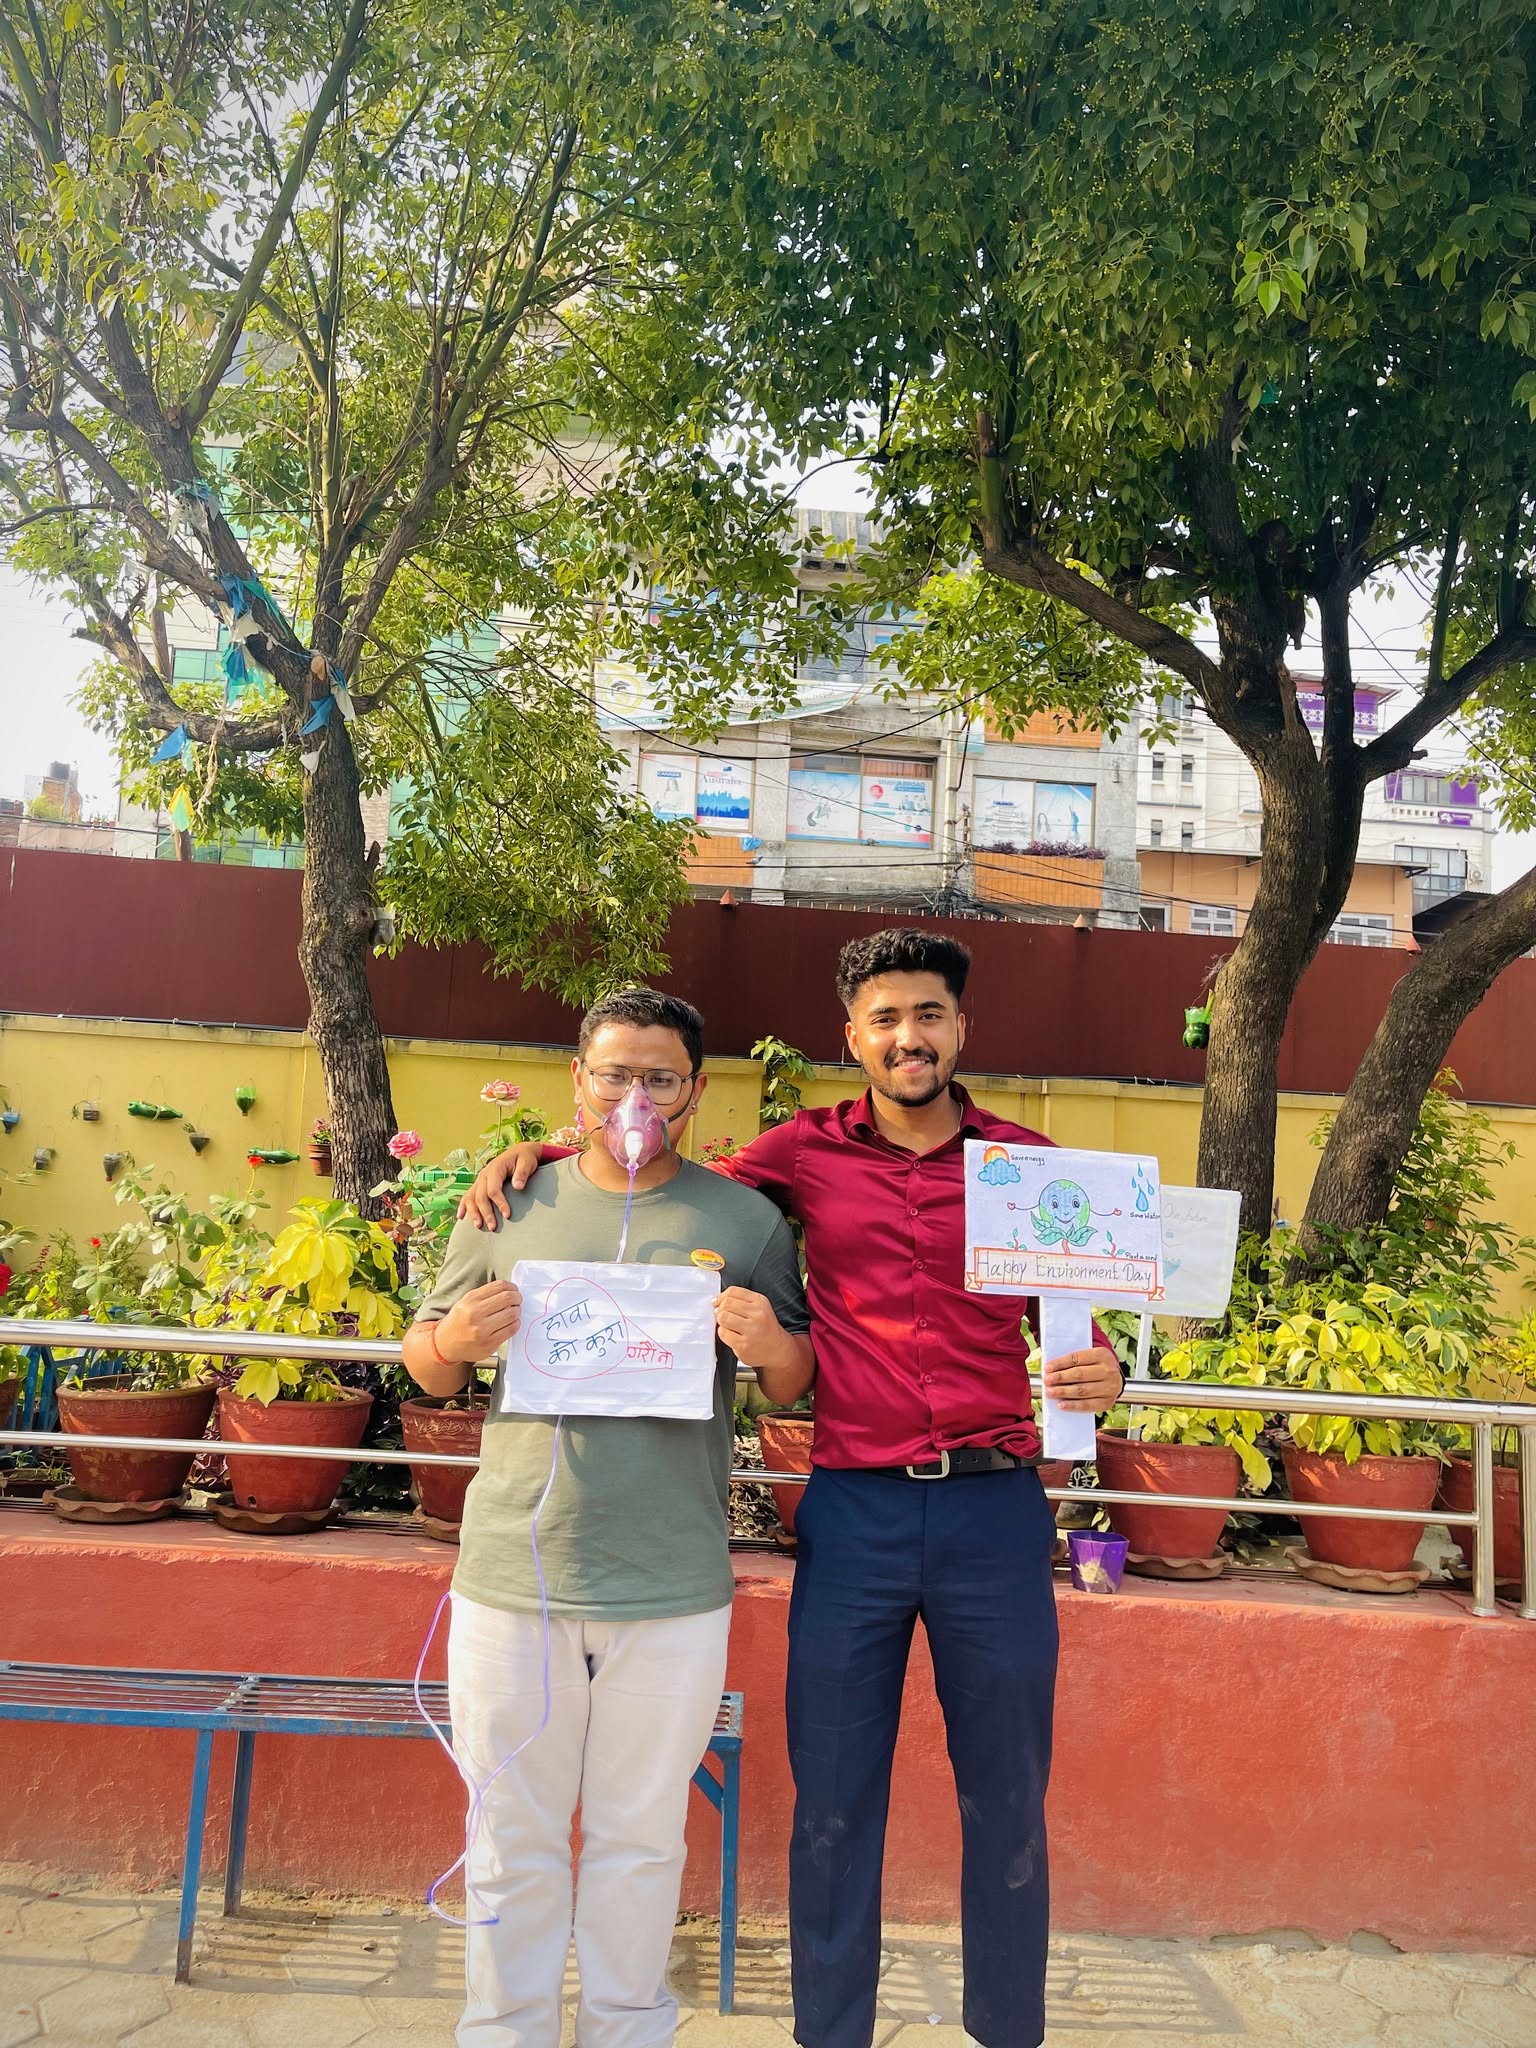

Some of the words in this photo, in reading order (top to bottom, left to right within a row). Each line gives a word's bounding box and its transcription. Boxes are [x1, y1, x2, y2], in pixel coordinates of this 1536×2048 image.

[977, 1250, 1028, 1285] Happy
[1122, 1262, 1152, 1290] Day
[541, 1298, 591, 1341] हावा
[585, 1320, 625, 1357] कुरा
